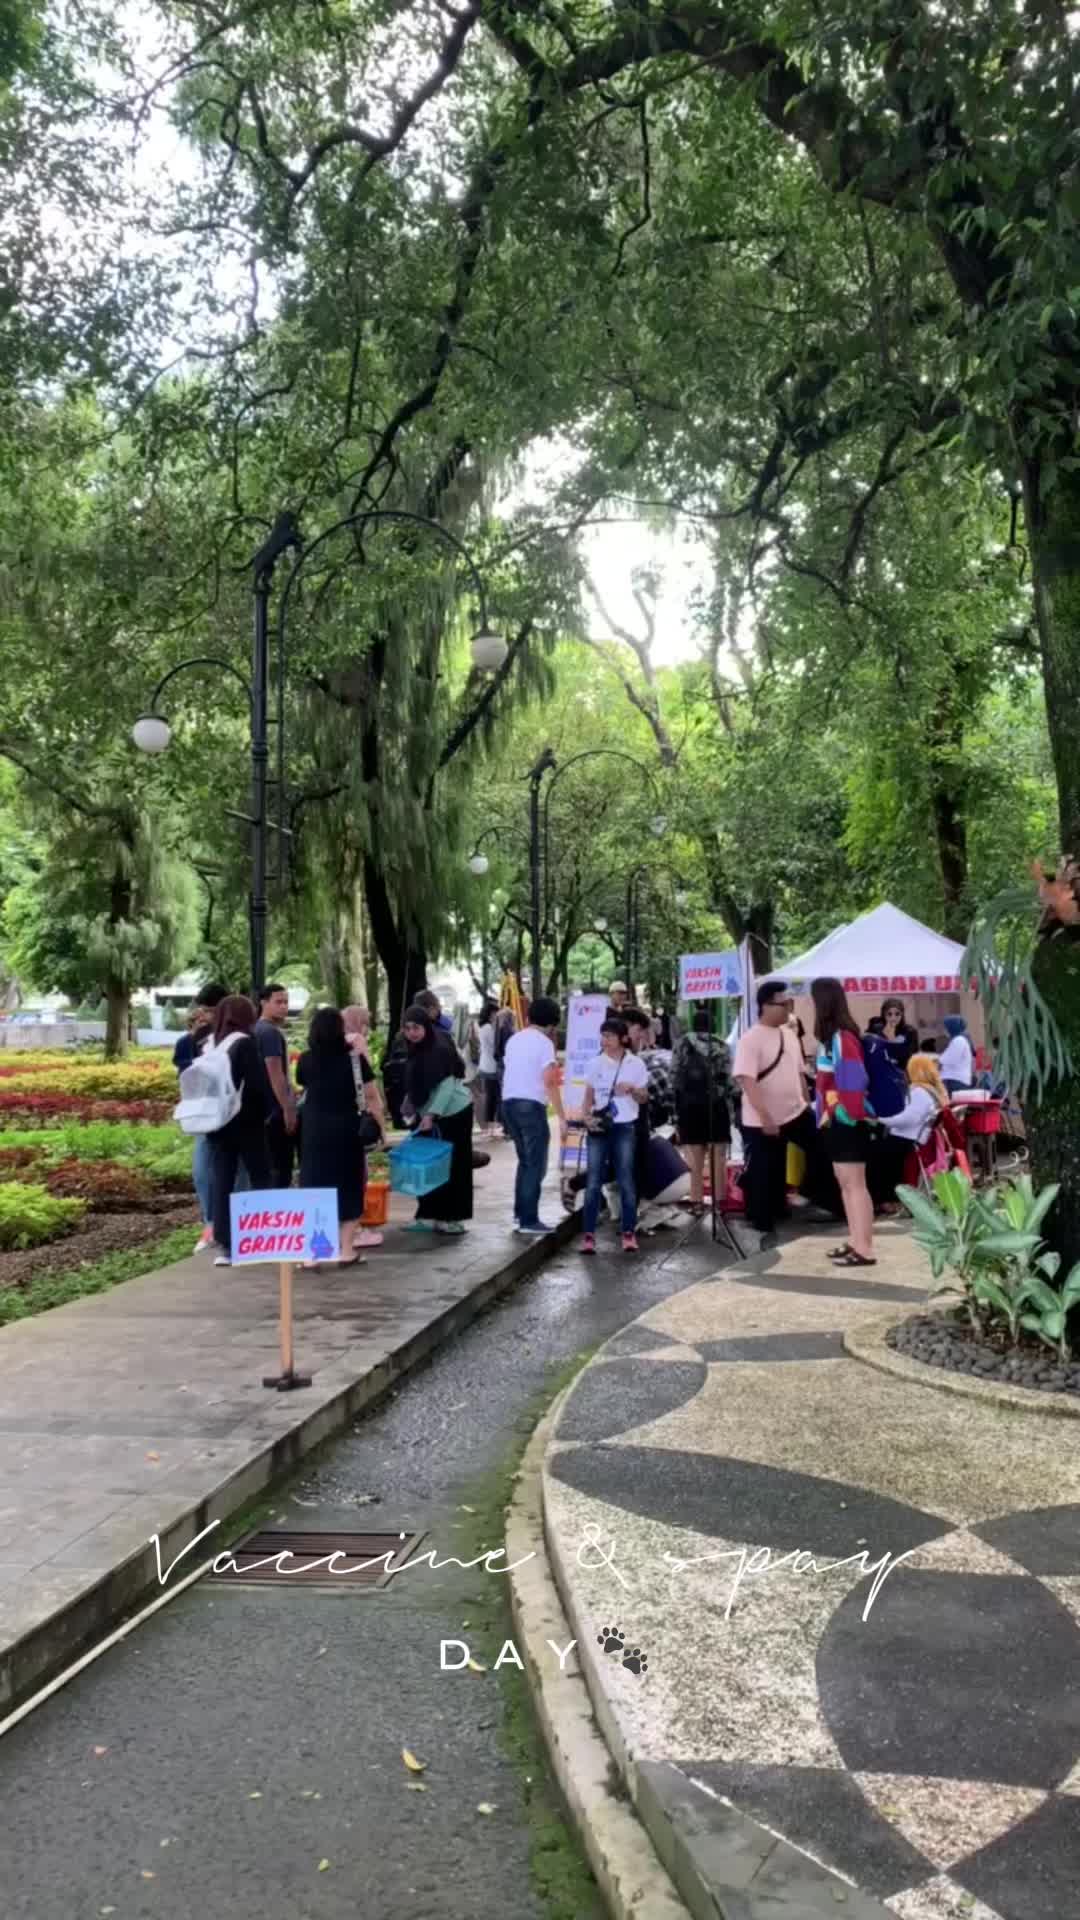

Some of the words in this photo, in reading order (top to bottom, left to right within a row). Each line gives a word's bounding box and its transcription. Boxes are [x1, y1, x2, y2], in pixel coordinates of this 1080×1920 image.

[843, 975, 928, 993] AGIAN
[238, 1210, 305, 1231] VAKSIN
[238, 1234, 306, 1255] GRATIS
